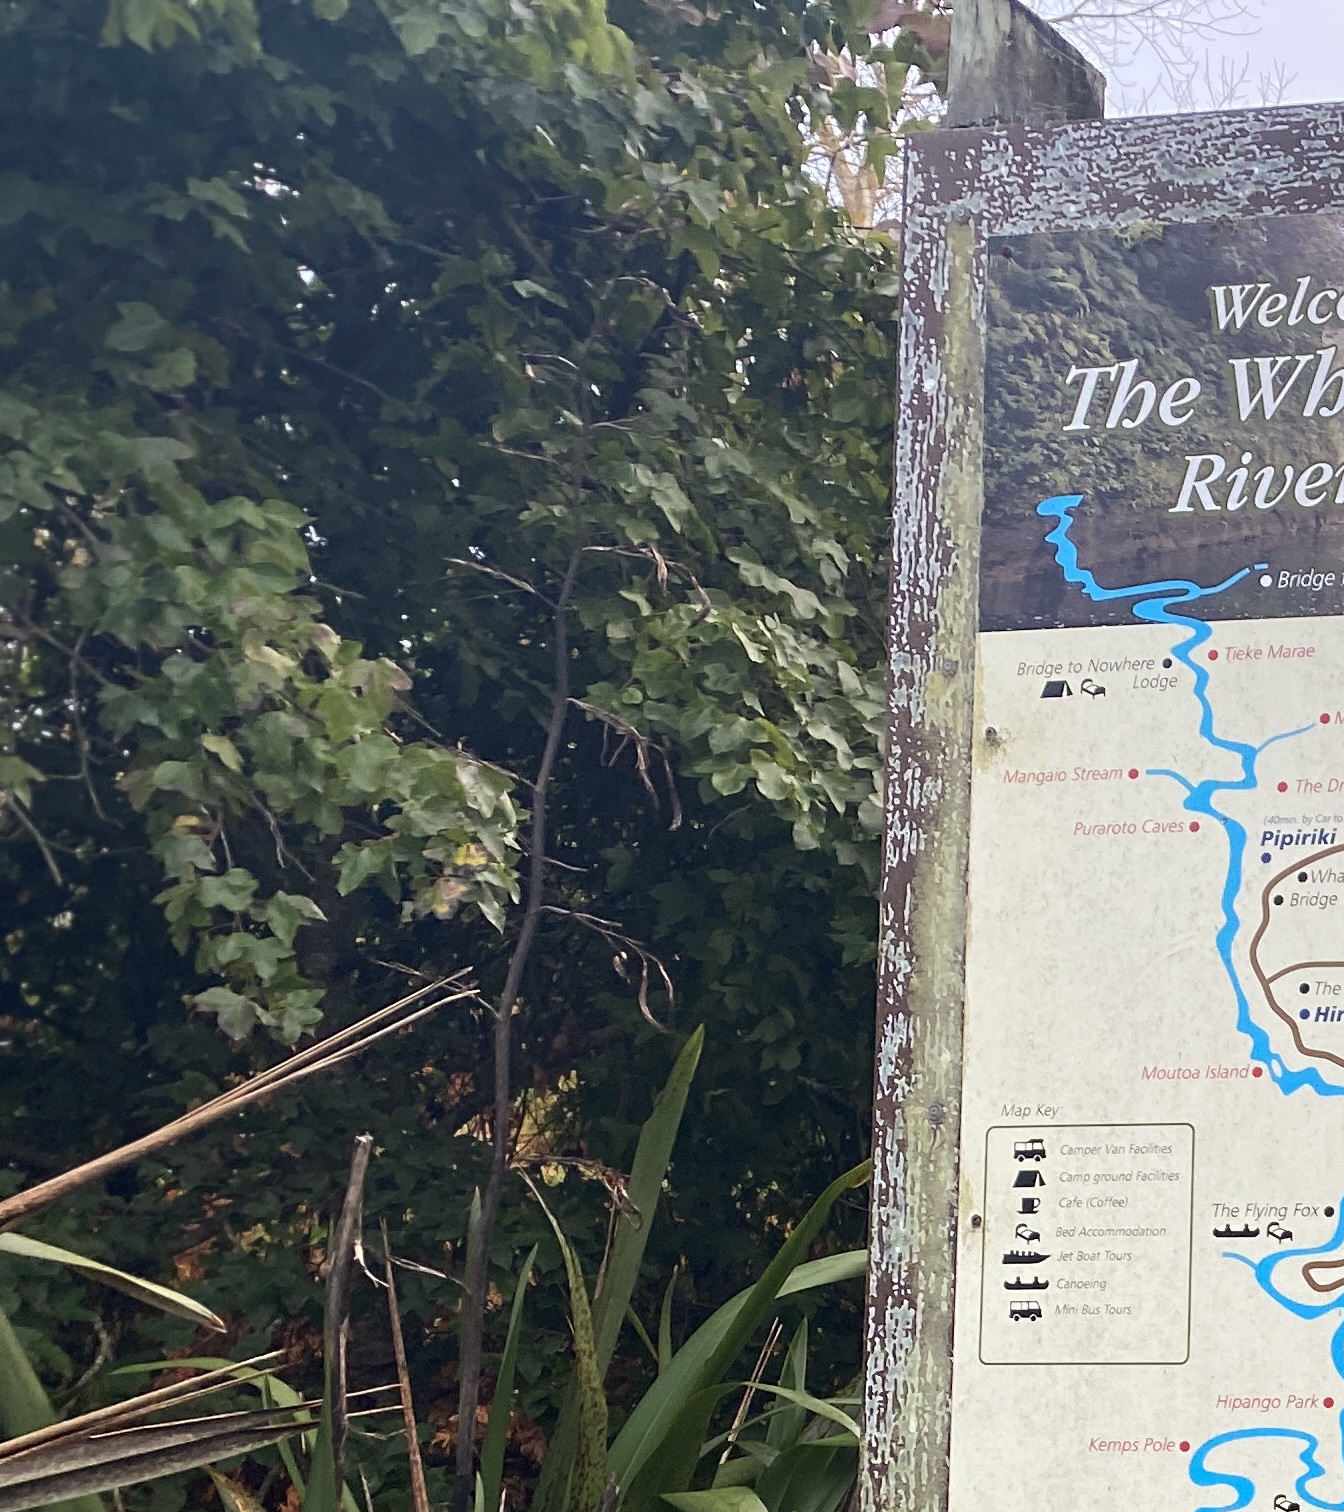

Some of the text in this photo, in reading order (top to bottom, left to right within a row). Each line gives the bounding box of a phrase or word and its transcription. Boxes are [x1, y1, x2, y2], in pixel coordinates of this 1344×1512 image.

[1064, 358, 1201, 432] The
[1277, 568, 1337, 590] Bridge
[1225, 645, 1315, 660] Tieke Marae
[1017, 656, 1154, 676] Bridge to Nowhere
[1133, 674, 1178, 691] Lodge
[1073, 766, 1122, 781] Stream
[1295, 779, 1323, 794] The
[1140, 820, 1184, 834] Caves
[1261, 828, 1337, 850] Pipiriki
[1289, 891, 1339, 910] Bridge
[1314, 981, 1342, 996] The
[1141, 1064, 1249, 1081] Moutoa Island
[1001, 1105, 1031, 1118] Map
[1059, 1197, 1083, 1208] Cafe
[1212, 1204, 1319, 1221] The Flying Fox
[1056, 1226, 1166, 1237] Bed Accommodation
[1057, 1251, 1132, 1261] Jet Boat Tours
[1057, 1278, 1107, 1291] Canoeing
[1055, 1304, 1132, 1315] Mini Bus Tours
[1216, 1395, 1318, 1412] Hipango Park
[1089, 1438, 1176, 1454] Kemps Pole
